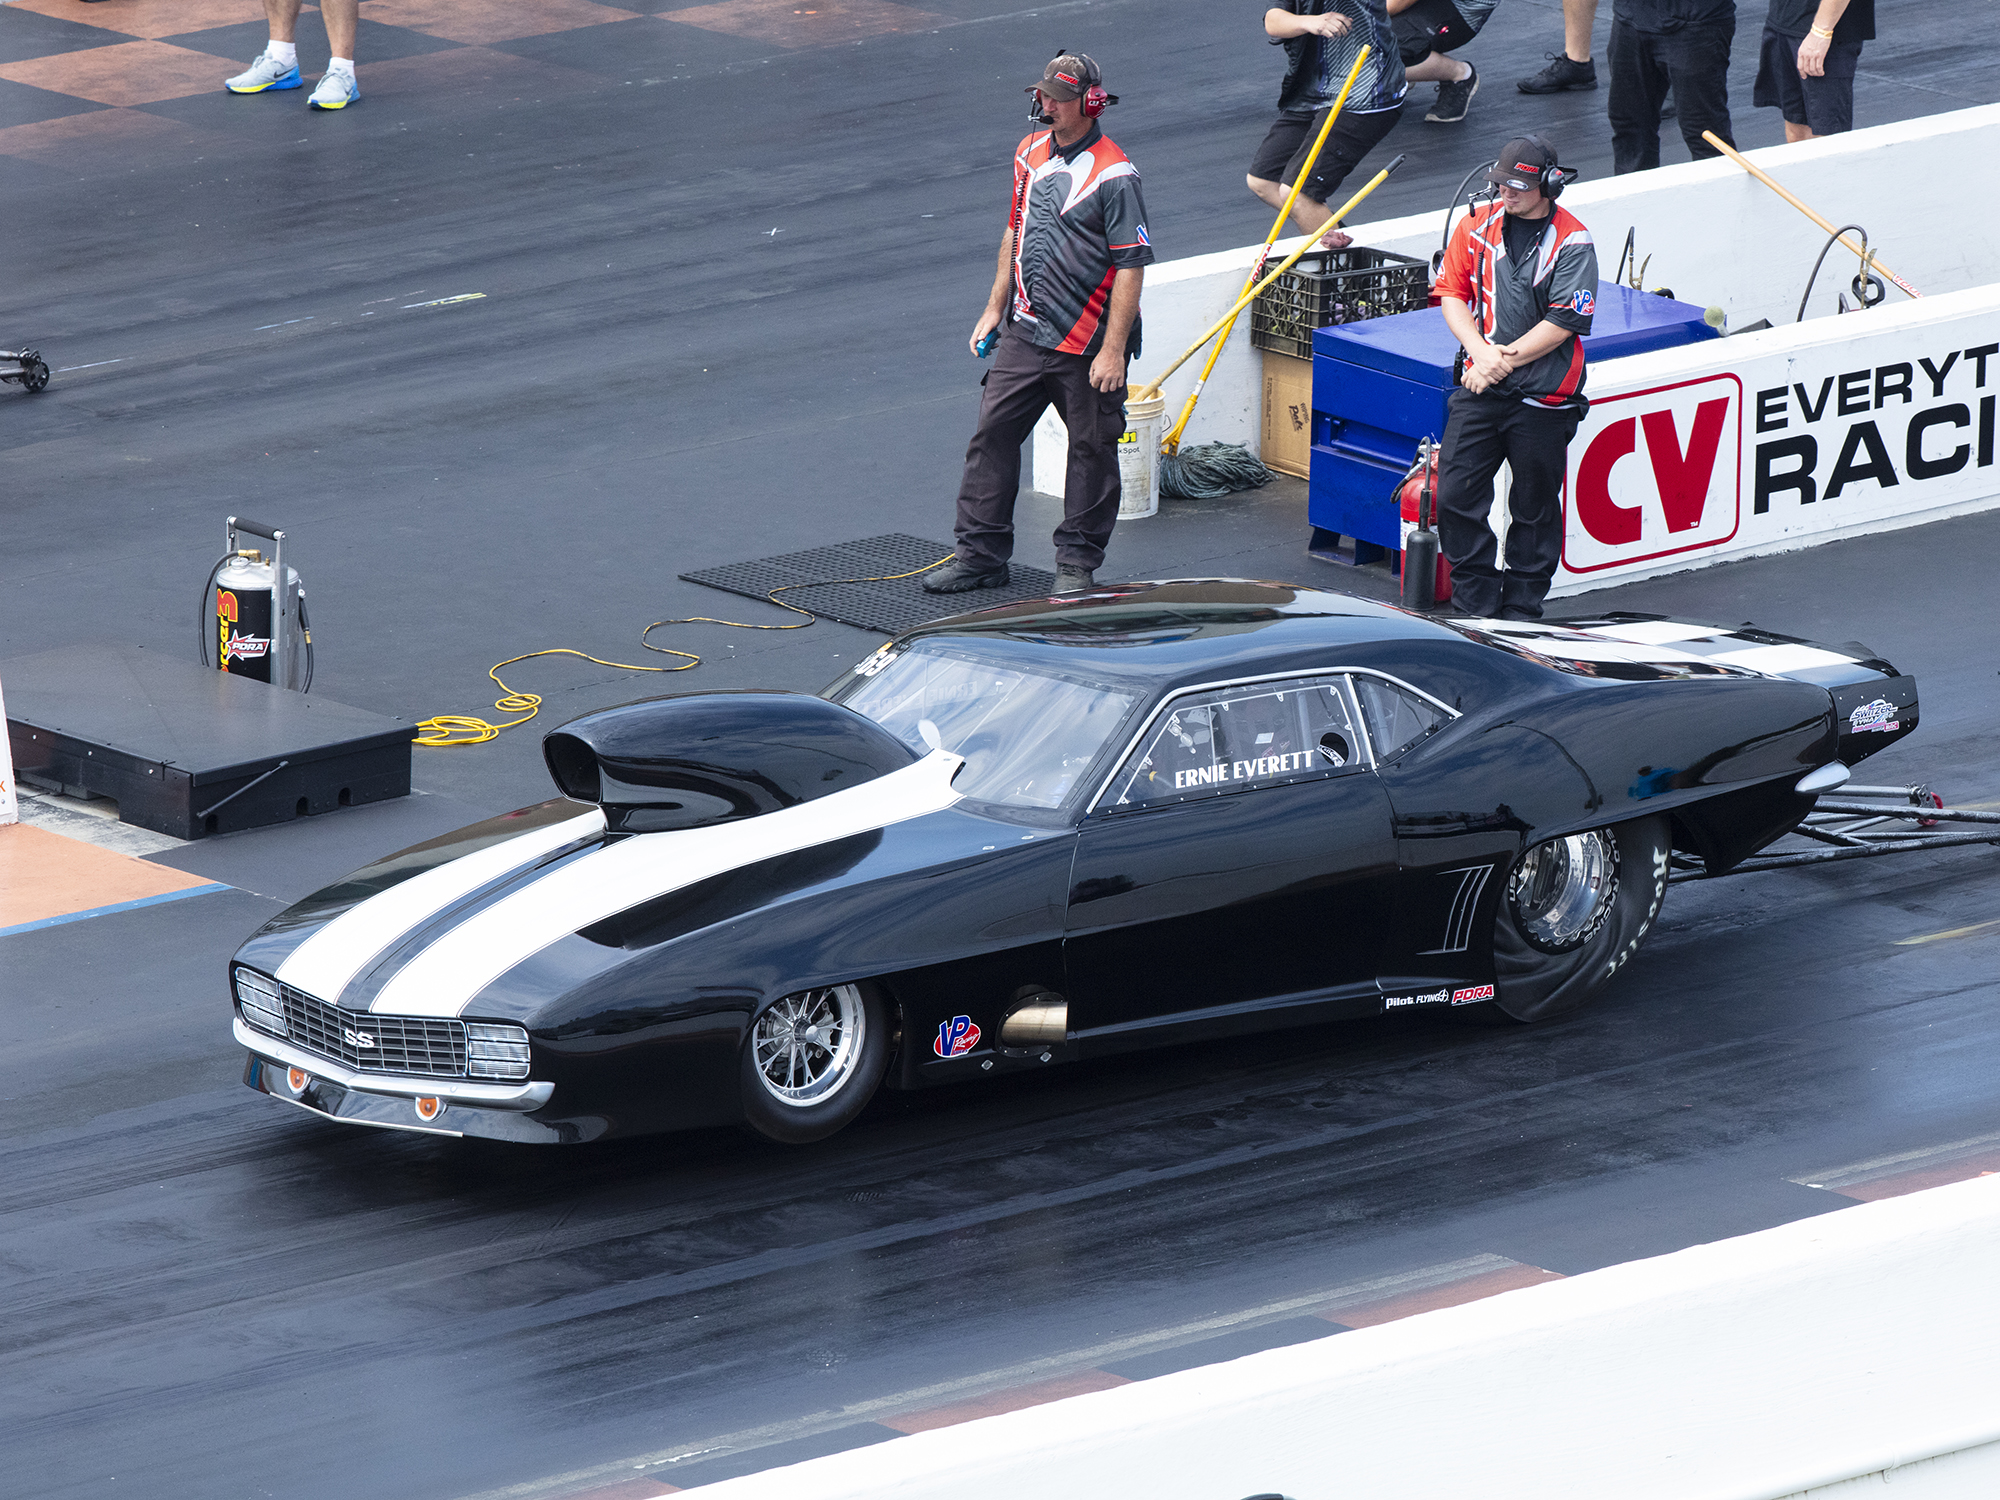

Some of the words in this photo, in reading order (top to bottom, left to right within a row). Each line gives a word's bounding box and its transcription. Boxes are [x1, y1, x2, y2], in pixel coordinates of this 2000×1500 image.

[1756, 342, 2000, 434] EVERYT
[1576, 396, 1730, 546] CV
[1754, 394, 1996, 515] RACI
[1175, 764, 1229, 789] ERNIE
[1233, 749, 1315, 780] EVERETT
[1451, 984, 1494, 1004] PDRA
[344, 1028, 375, 1048] SS
[938, 1015, 971, 1057] VP
